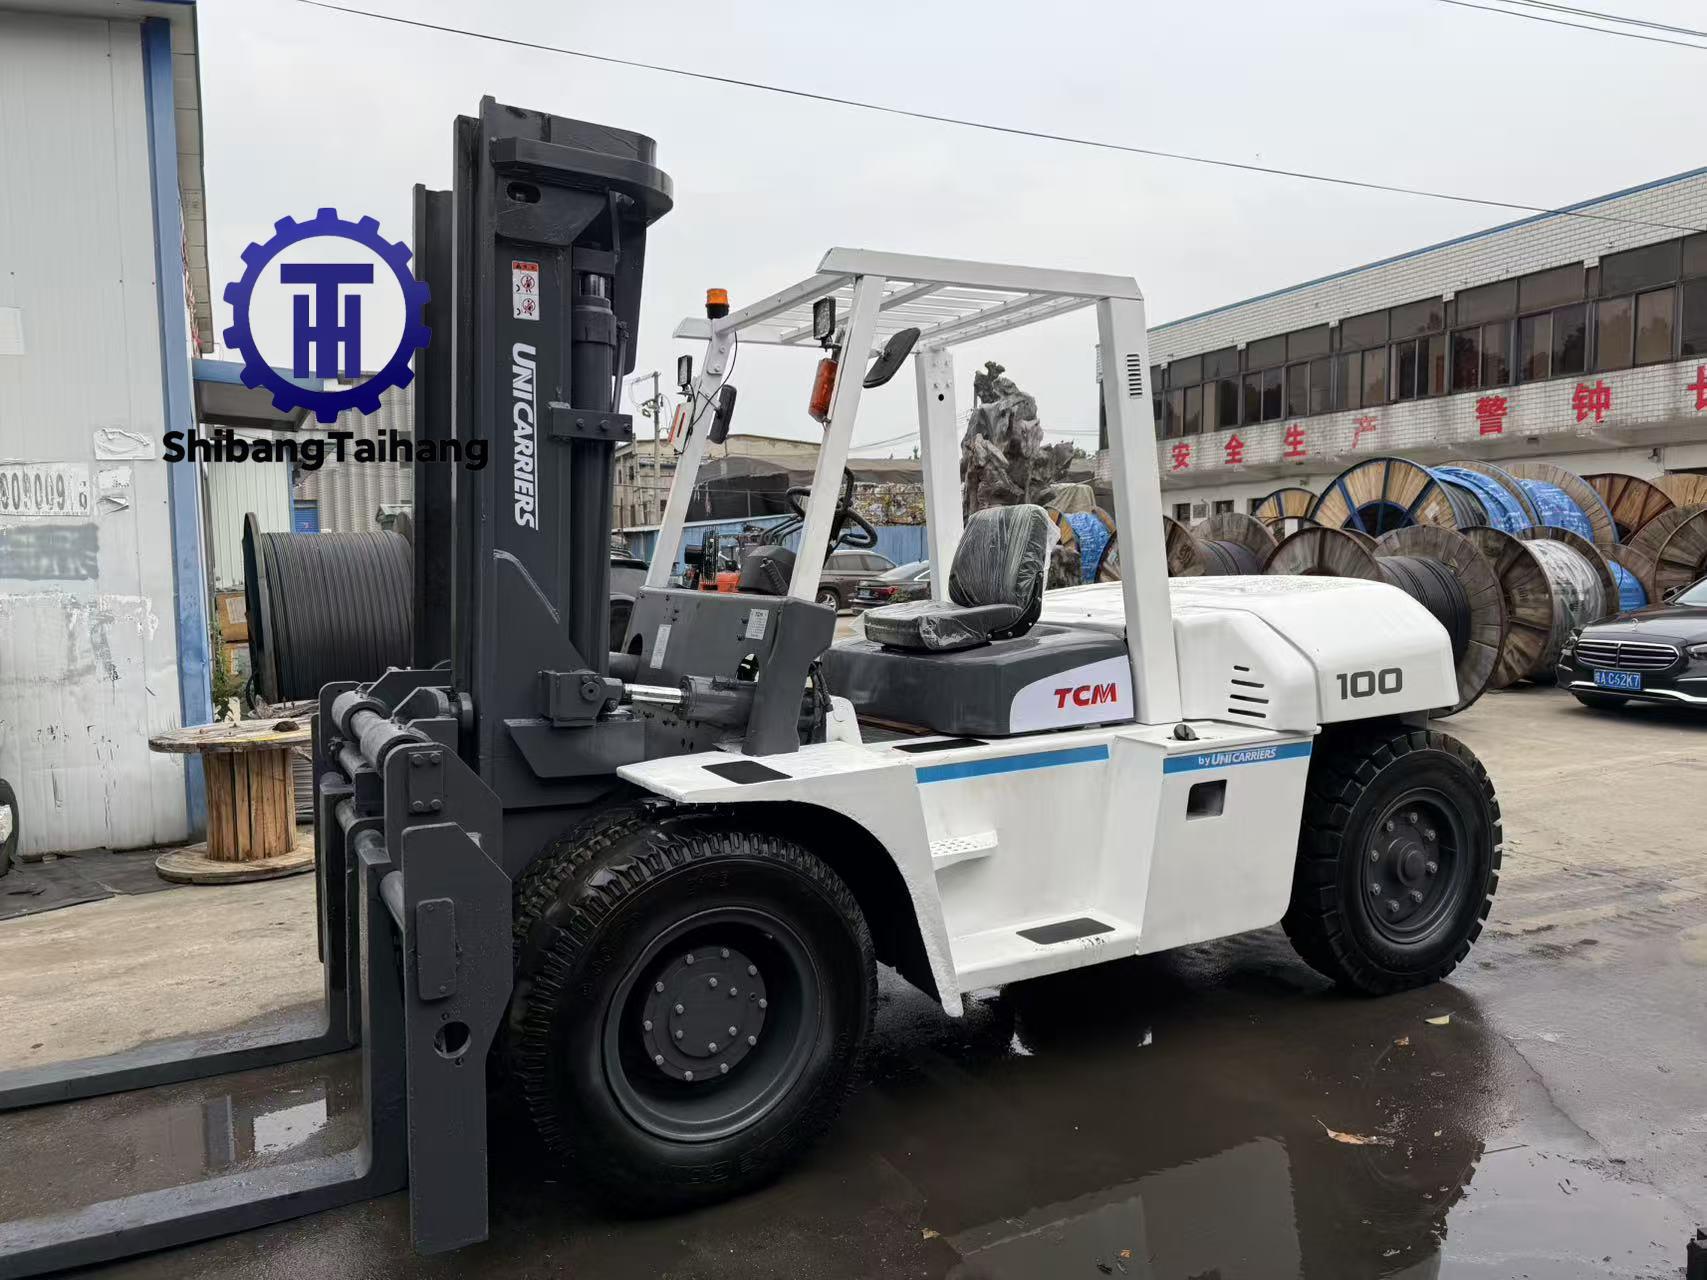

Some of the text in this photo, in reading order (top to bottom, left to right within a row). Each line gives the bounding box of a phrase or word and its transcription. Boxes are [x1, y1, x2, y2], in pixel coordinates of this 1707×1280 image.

[512, 342, 537, 528] UNICARRIERS
[1054, 682, 1117, 708] TCM
[1336, 667, 1403, 700] 100
[1198, 748, 1276, 766] by UNICARRIERS
